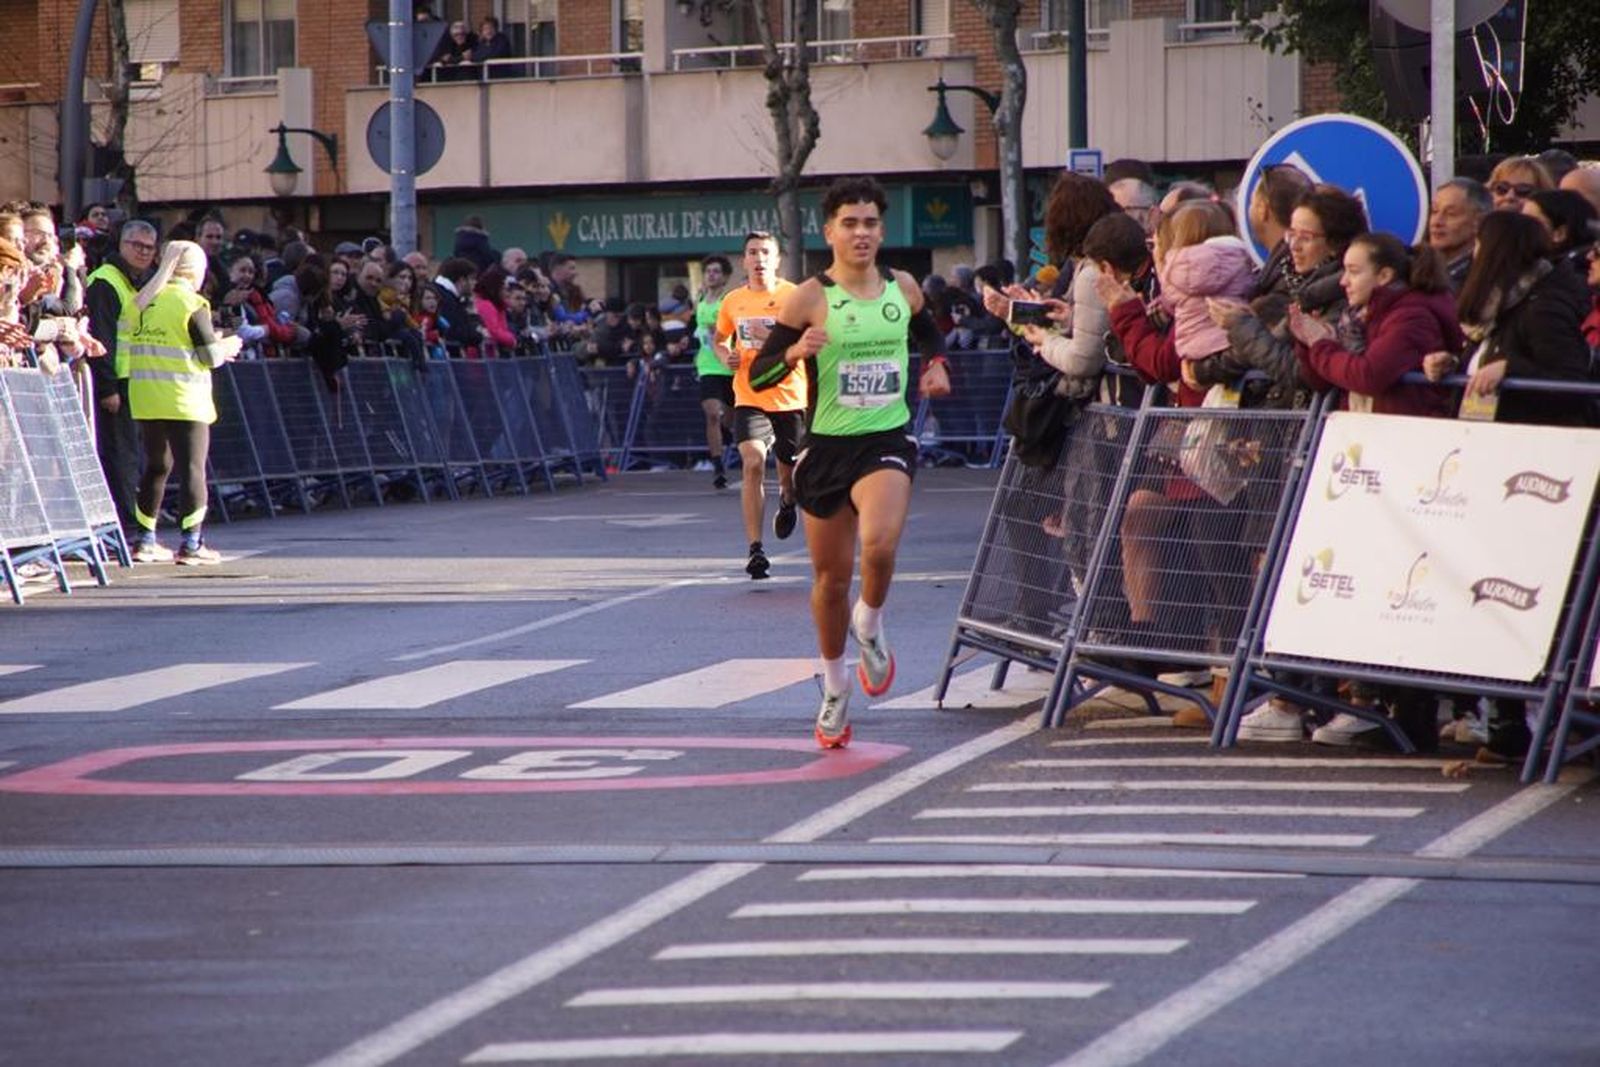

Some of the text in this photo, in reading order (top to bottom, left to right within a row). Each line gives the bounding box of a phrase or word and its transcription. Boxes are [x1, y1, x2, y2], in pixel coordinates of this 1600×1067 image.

[577, 214, 619, 249] CAJA
[622, 212, 679, 240] RURAL
[682, 211, 704, 238] DE
[847, 372, 888, 392] 5572
[1339, 468, 1381, 487] SETEL
[1309, 572, 1355, 591] SETEL
